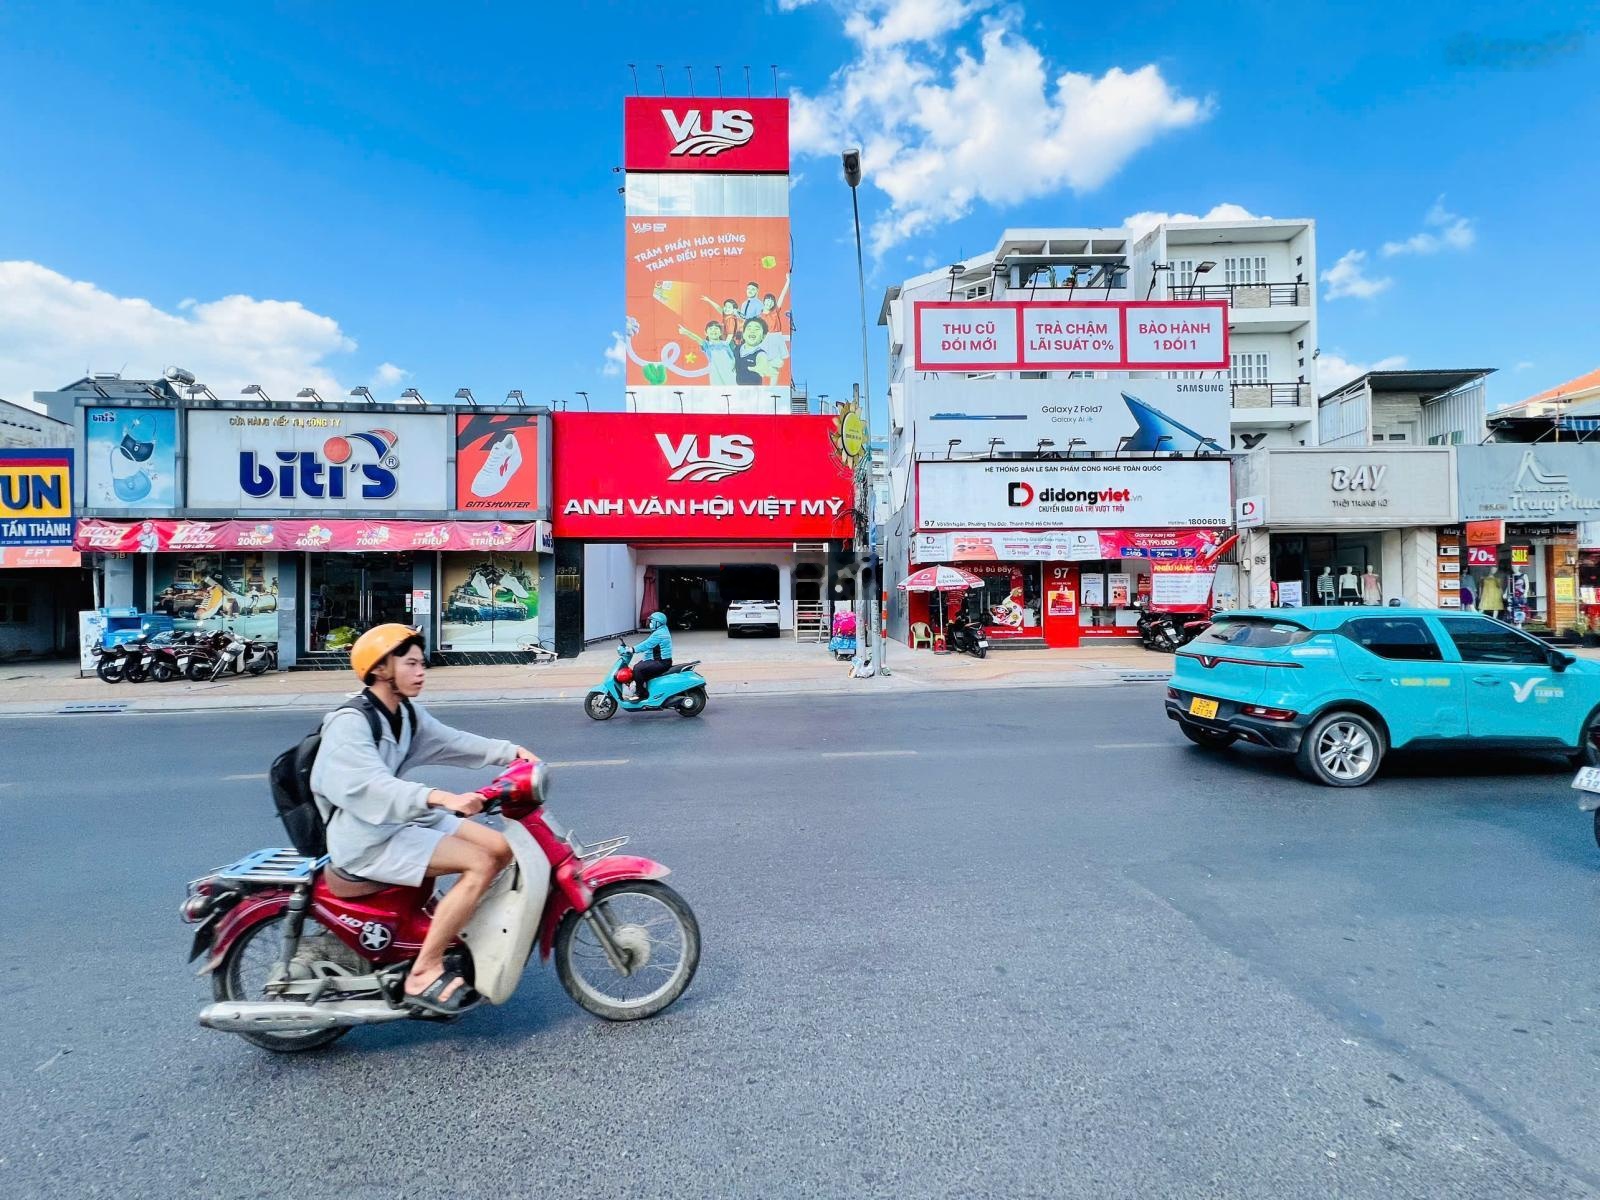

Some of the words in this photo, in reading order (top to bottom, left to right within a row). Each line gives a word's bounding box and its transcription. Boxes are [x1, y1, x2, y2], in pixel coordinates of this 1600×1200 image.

[661, 109, 754, 146] VUS
[700, 247, 720, 259] HỌC
[723, 247, 744, 256] HAY
[942, 324, 972, 334] THU
[975, 321, 996, 334] CŨ
[1036, 320, 1063, 334] TRẢ
[1065, 320, 1108, 337] CHẬM
[1139, 320, 1168, 334] BẢO
[1170, 320, 1211, 334] HÀNH
[941, 337, 967, 351] ĐỔI
[970, 337, 997, 351] MỚI
[1030, 337, 1051, 351] LÃI
[1054, 336, 1090, 351] SUẤT
[1092, 340, 1114, 351] 0%
[1153, 340, 1160, 350] 1
[1163, 337, 1188, 351] ĐỔI
[1190, 340, 1196, 350] 1
[1176, 384, 1224, 393] SAMSUNG
[1041, 405, 1073, 416] Galaxy
[1080, 405, 1103, 413] Fold7
[330, 418, 341, 426] TY
[1051, 416, 1078, 424] Galaxy
[655, 434, 755, 470] VUS
[240, 436, 398, 499] biti's
[1021, 464, 1035, 472] BÁN
[1123, 464, 1141, 472] TOÀN
[1331, 465, 1387, 491] BAY
[1039, 488, 1143, 504] didongviet.vn
[563, 498, 624, 516] ANH
[628, 495, 687, 516] VĂN
[690, 495, 735, 520] HỘI
[739, 495, 797, 520] VIỆT
[801, 497, 844, 516] MỸ
[1061, 505, 1074, 513] GIAO
[1074, 504, 1084, 513] GIÁ
[28, 520, 71, 537] THÀNH
[237, 537, 263, 546] 200K
[295, 537, 320, 547] 400K
[355, 538, 380, 546] 700K
[24, 548, 54, 557] FPT
[1511, 549, 1529, 562] SALE
[1054, 568, 1069, 579] 97
